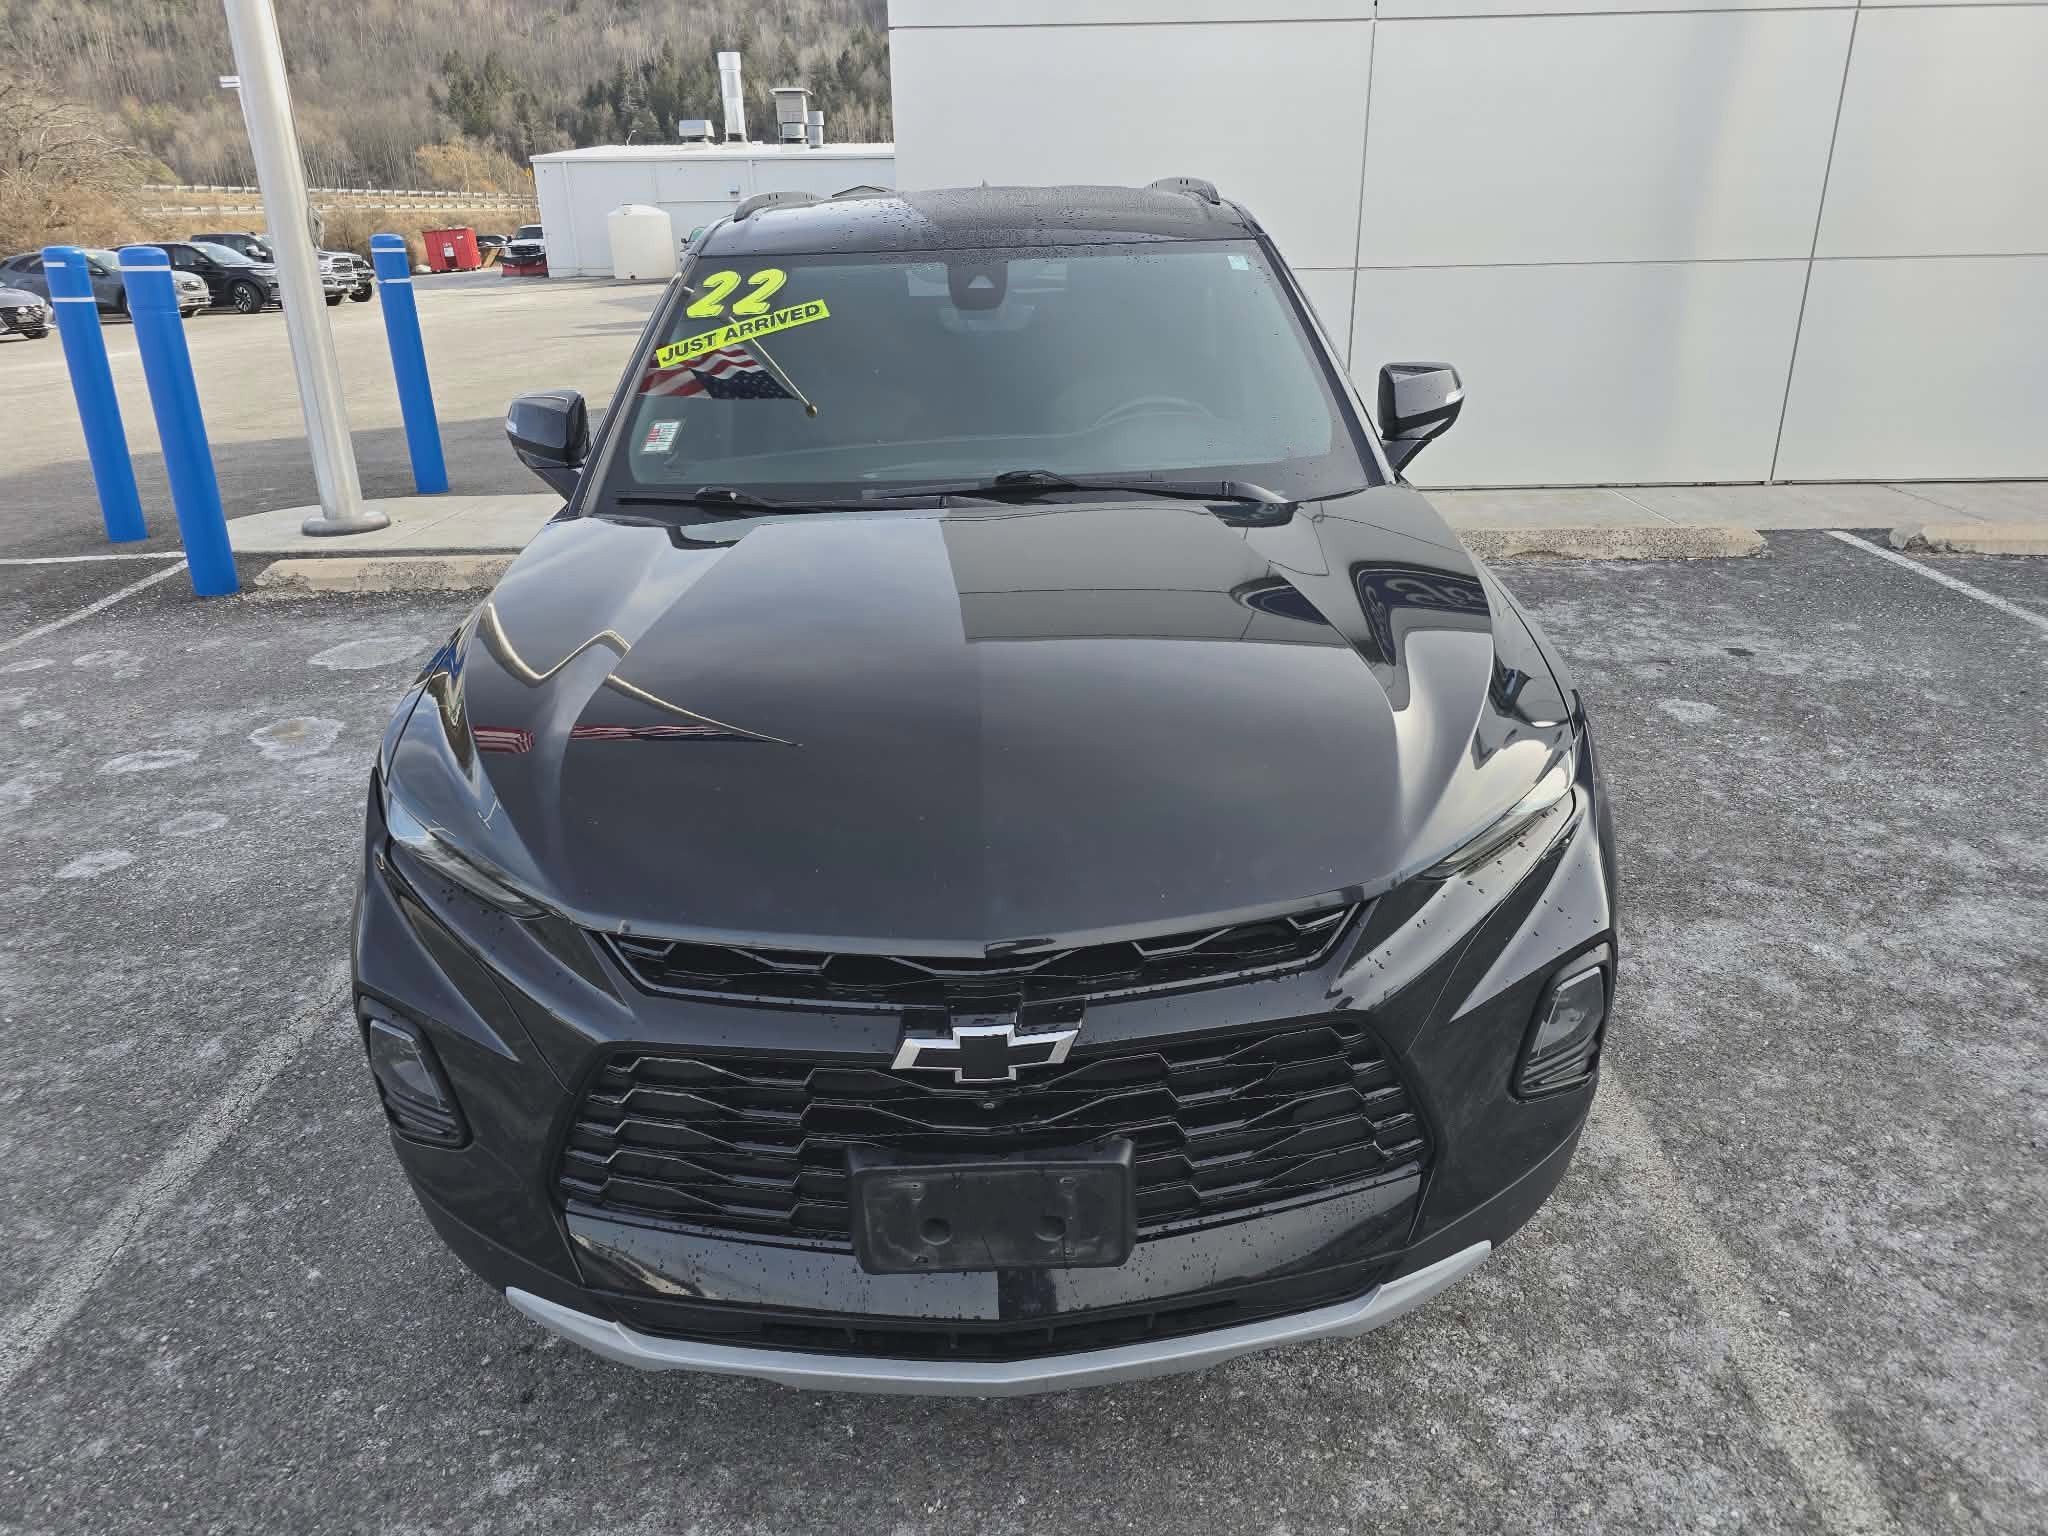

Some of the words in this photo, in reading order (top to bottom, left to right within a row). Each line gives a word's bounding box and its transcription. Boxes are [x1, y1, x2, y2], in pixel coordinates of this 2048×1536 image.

[687, 268, 787, 318] 22
[662, 333, 717, 362] JUST
[724, 304, 820, 341] ARRIVED
